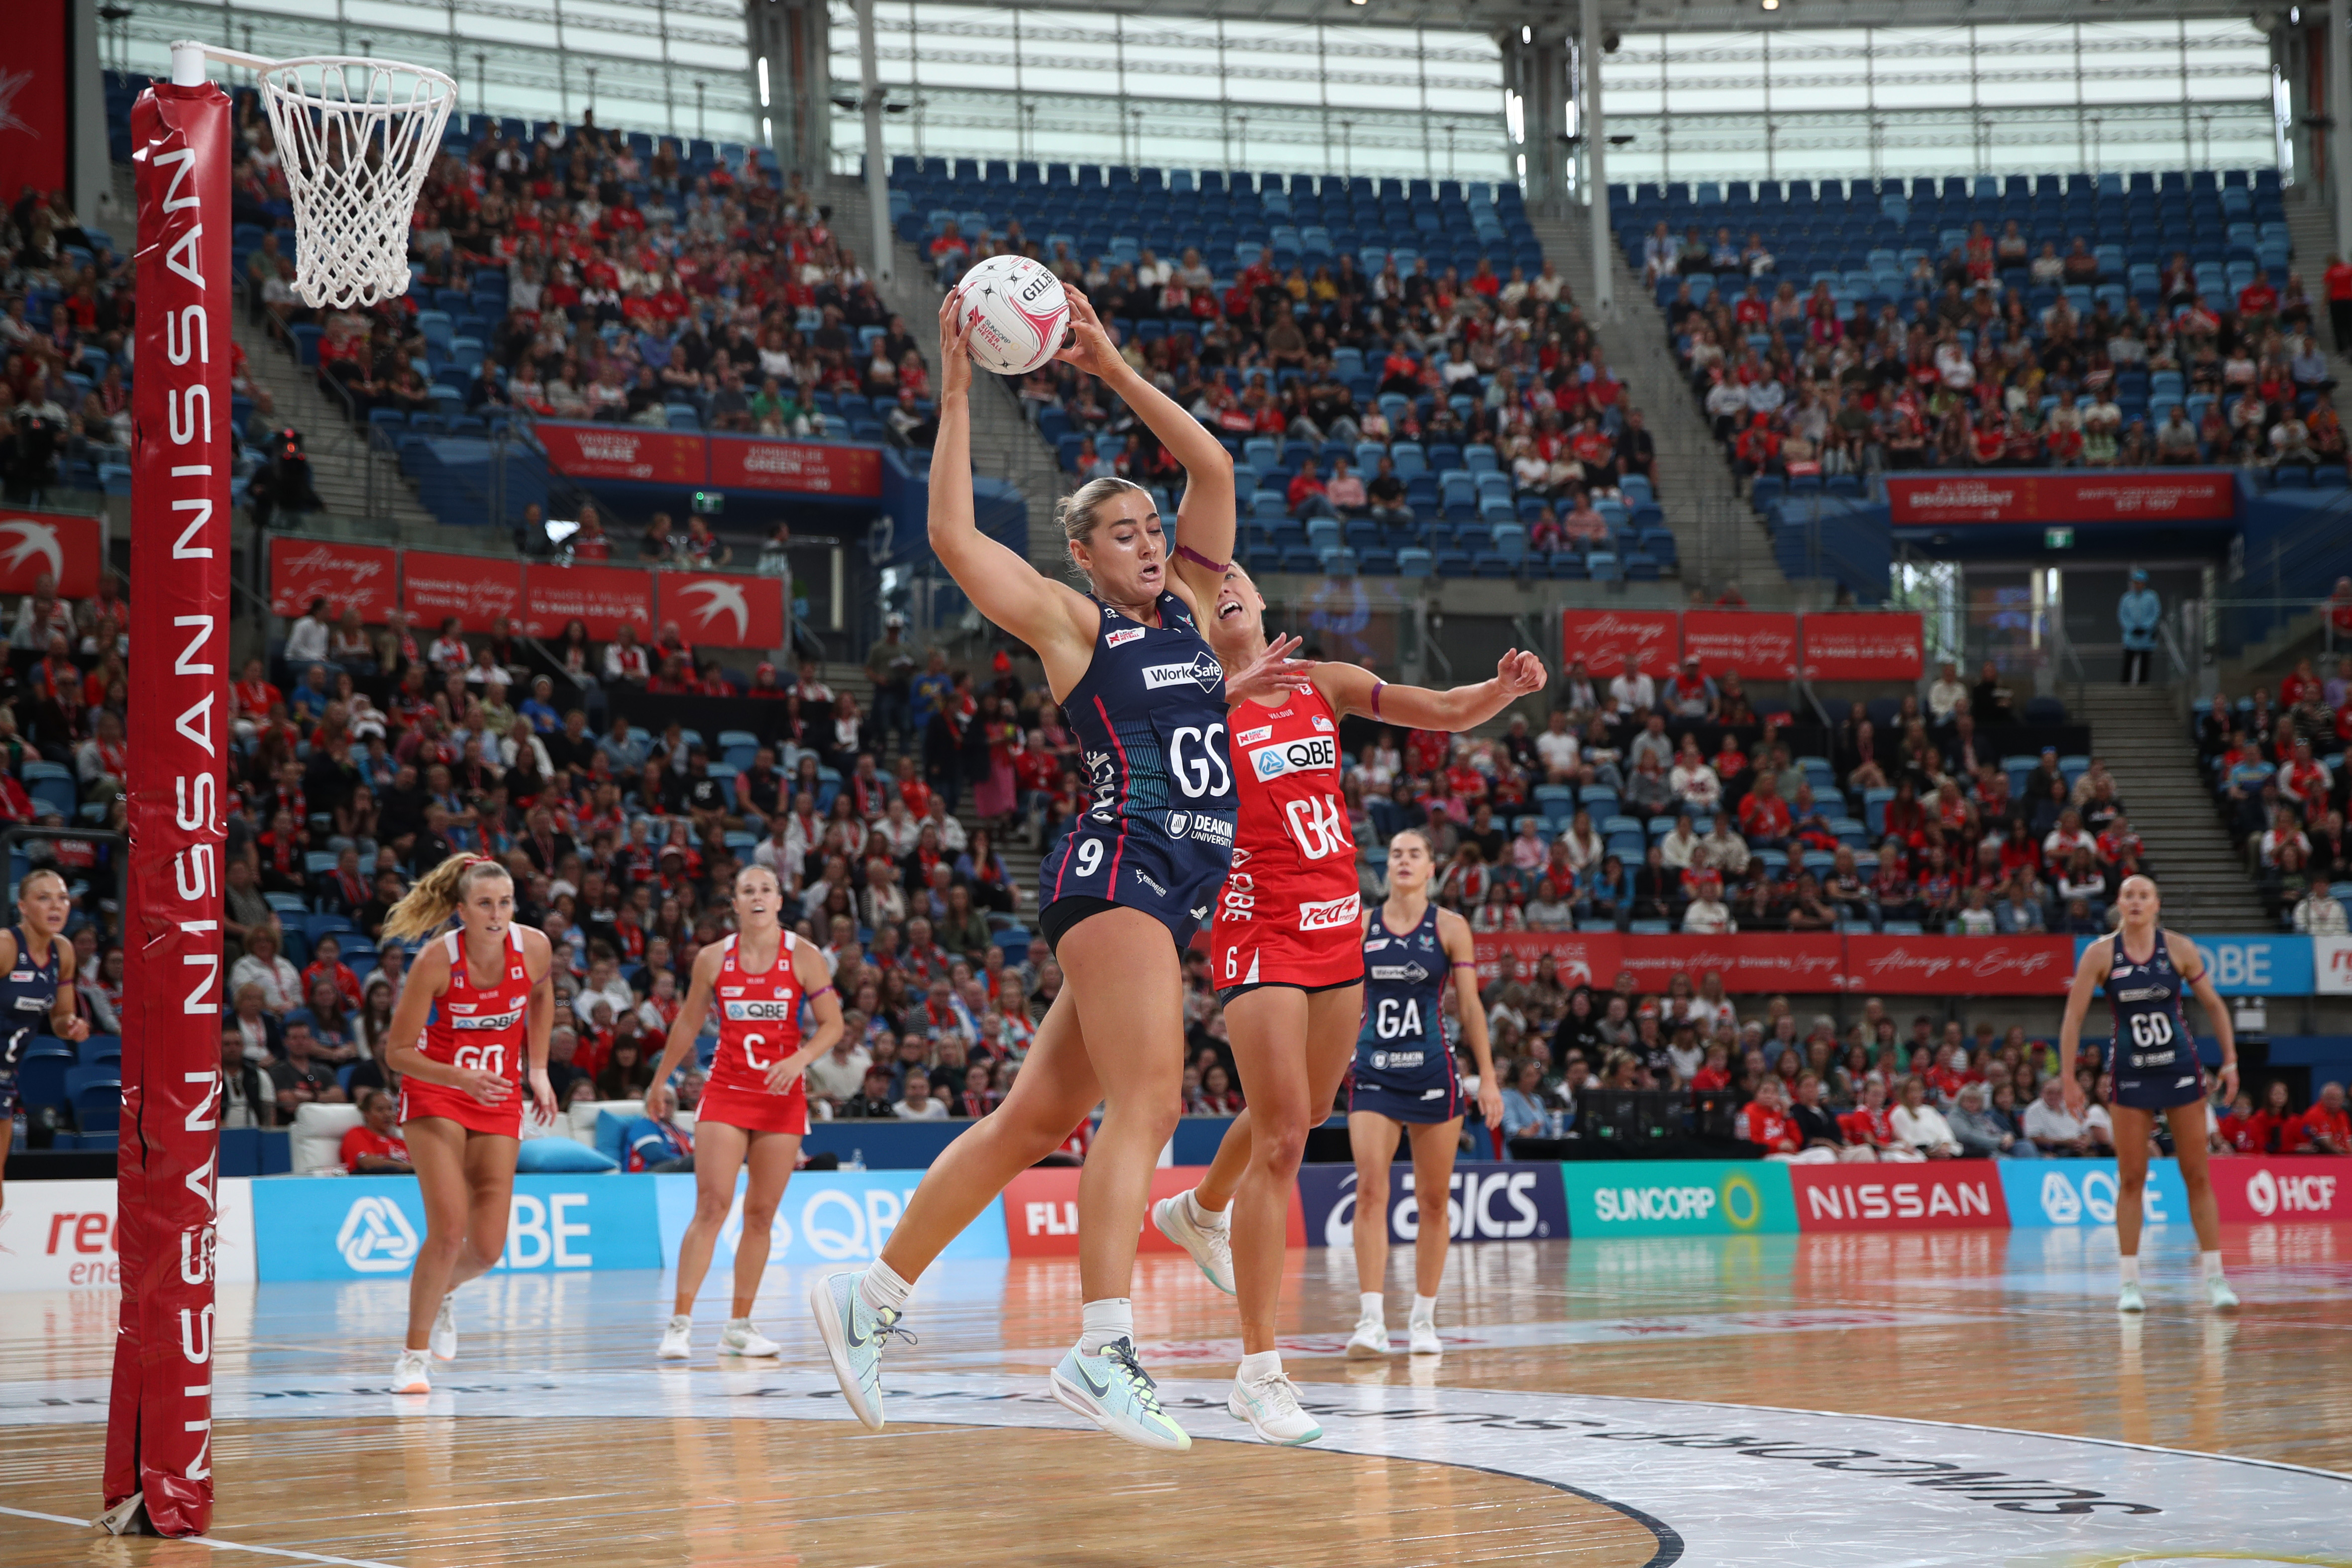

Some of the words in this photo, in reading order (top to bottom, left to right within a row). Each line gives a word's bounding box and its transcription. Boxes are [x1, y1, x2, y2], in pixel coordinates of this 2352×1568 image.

[977, 327, 1002, 353] NETBALL
[981, 323, 1000, 343] SUPER
[985, 319, 1011, 343] SUNCORP
[153, 148, 213, 560] NISSAN
[582, 447, 635, 463] WARE
[744, 456, 801, 474] GREEN
[1268, 709, 1294, 720] VALOUR
[1170, 723, 1231, 798] GS
[1286, 740, 1334, 767] QBE
[173, 615, 218, 1014] NISSAN
[1194, 815, 1233, 838] DEAKIN
[1286, 794, 1353, 860] GH
[1191, 830, 1232, 848] UNIVERSITY
[1075, 838, 1104, 877] 9
[1221, 872, 1255, 922] QBE
[1303, 898, 1350, 927] red
[1339, 914, 1356, 922] energy
[1225, 945, 1238, 979] 6
[747, 1002, 786, 1019] QBE
[1376, 997, 1423, 1040] GA
[2130, 1011, 2174, 1047] GD
[743, 1033, 771, 1070] C
[1390, 1050, 1424, 1063] DEAKIN
[1595, 1186, 1716, 1222] SUNCORP
[1806, 1181, 1990, 1220] NISSAN
[2082, 1169, 2168, 1223] QE
[2279, 1175, 2338, 1211] HCF
[46, 1211, 119, 1256] re
[497, 1193, 593, 1270] BE
[801, 1188, 917, 1260] QB
[68, 1258, 121, 1285] ene
[180, 1071, 217, 1481] NISSAN
[1585, 1432, 2163, 1515] SUNCORP
